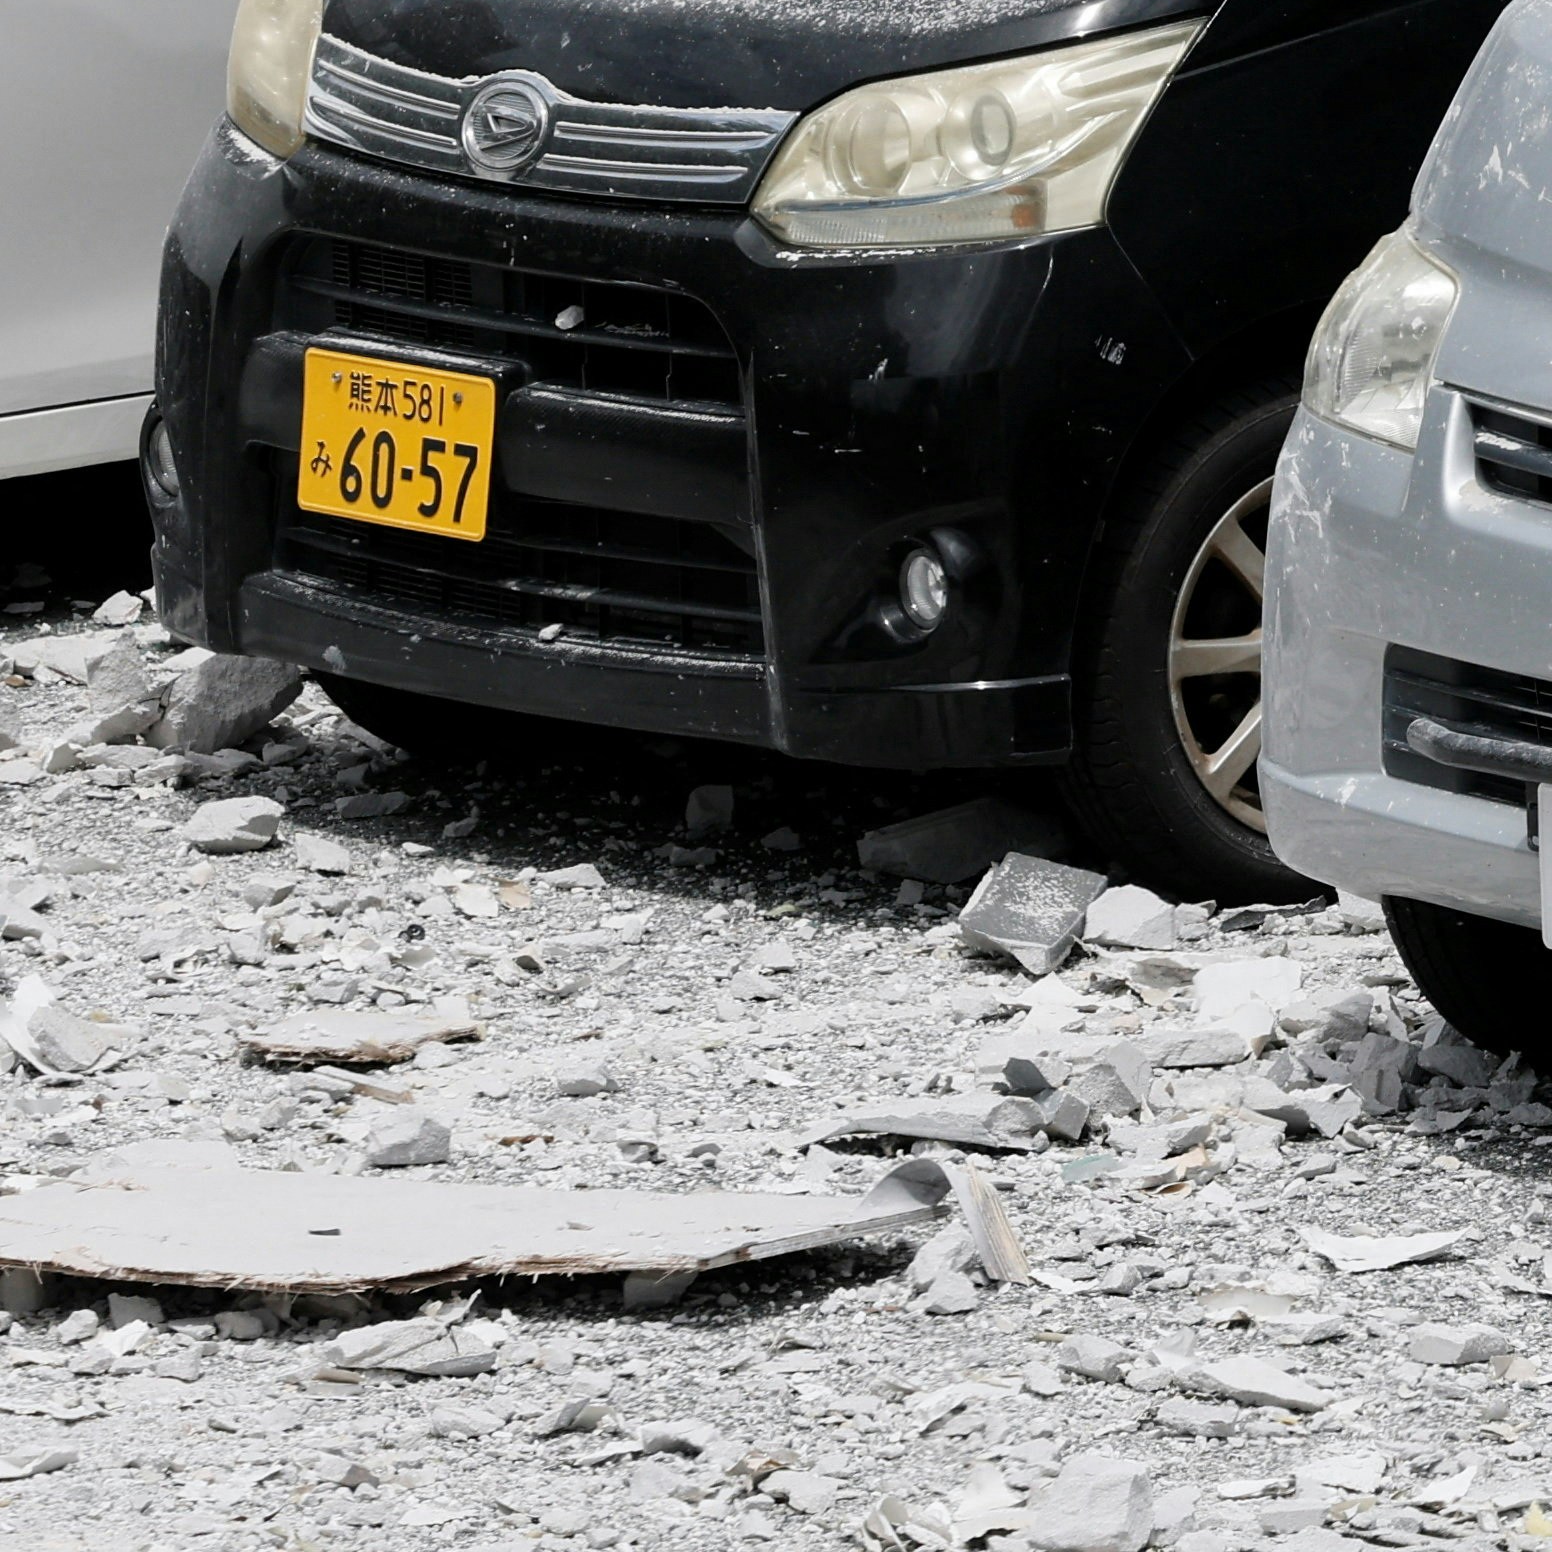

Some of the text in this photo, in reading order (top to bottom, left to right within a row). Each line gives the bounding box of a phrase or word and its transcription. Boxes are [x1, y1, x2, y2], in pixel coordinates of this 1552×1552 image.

[348, 371, 445, 427] 熊本581
[310, 426, 480, 525] み 60-57
